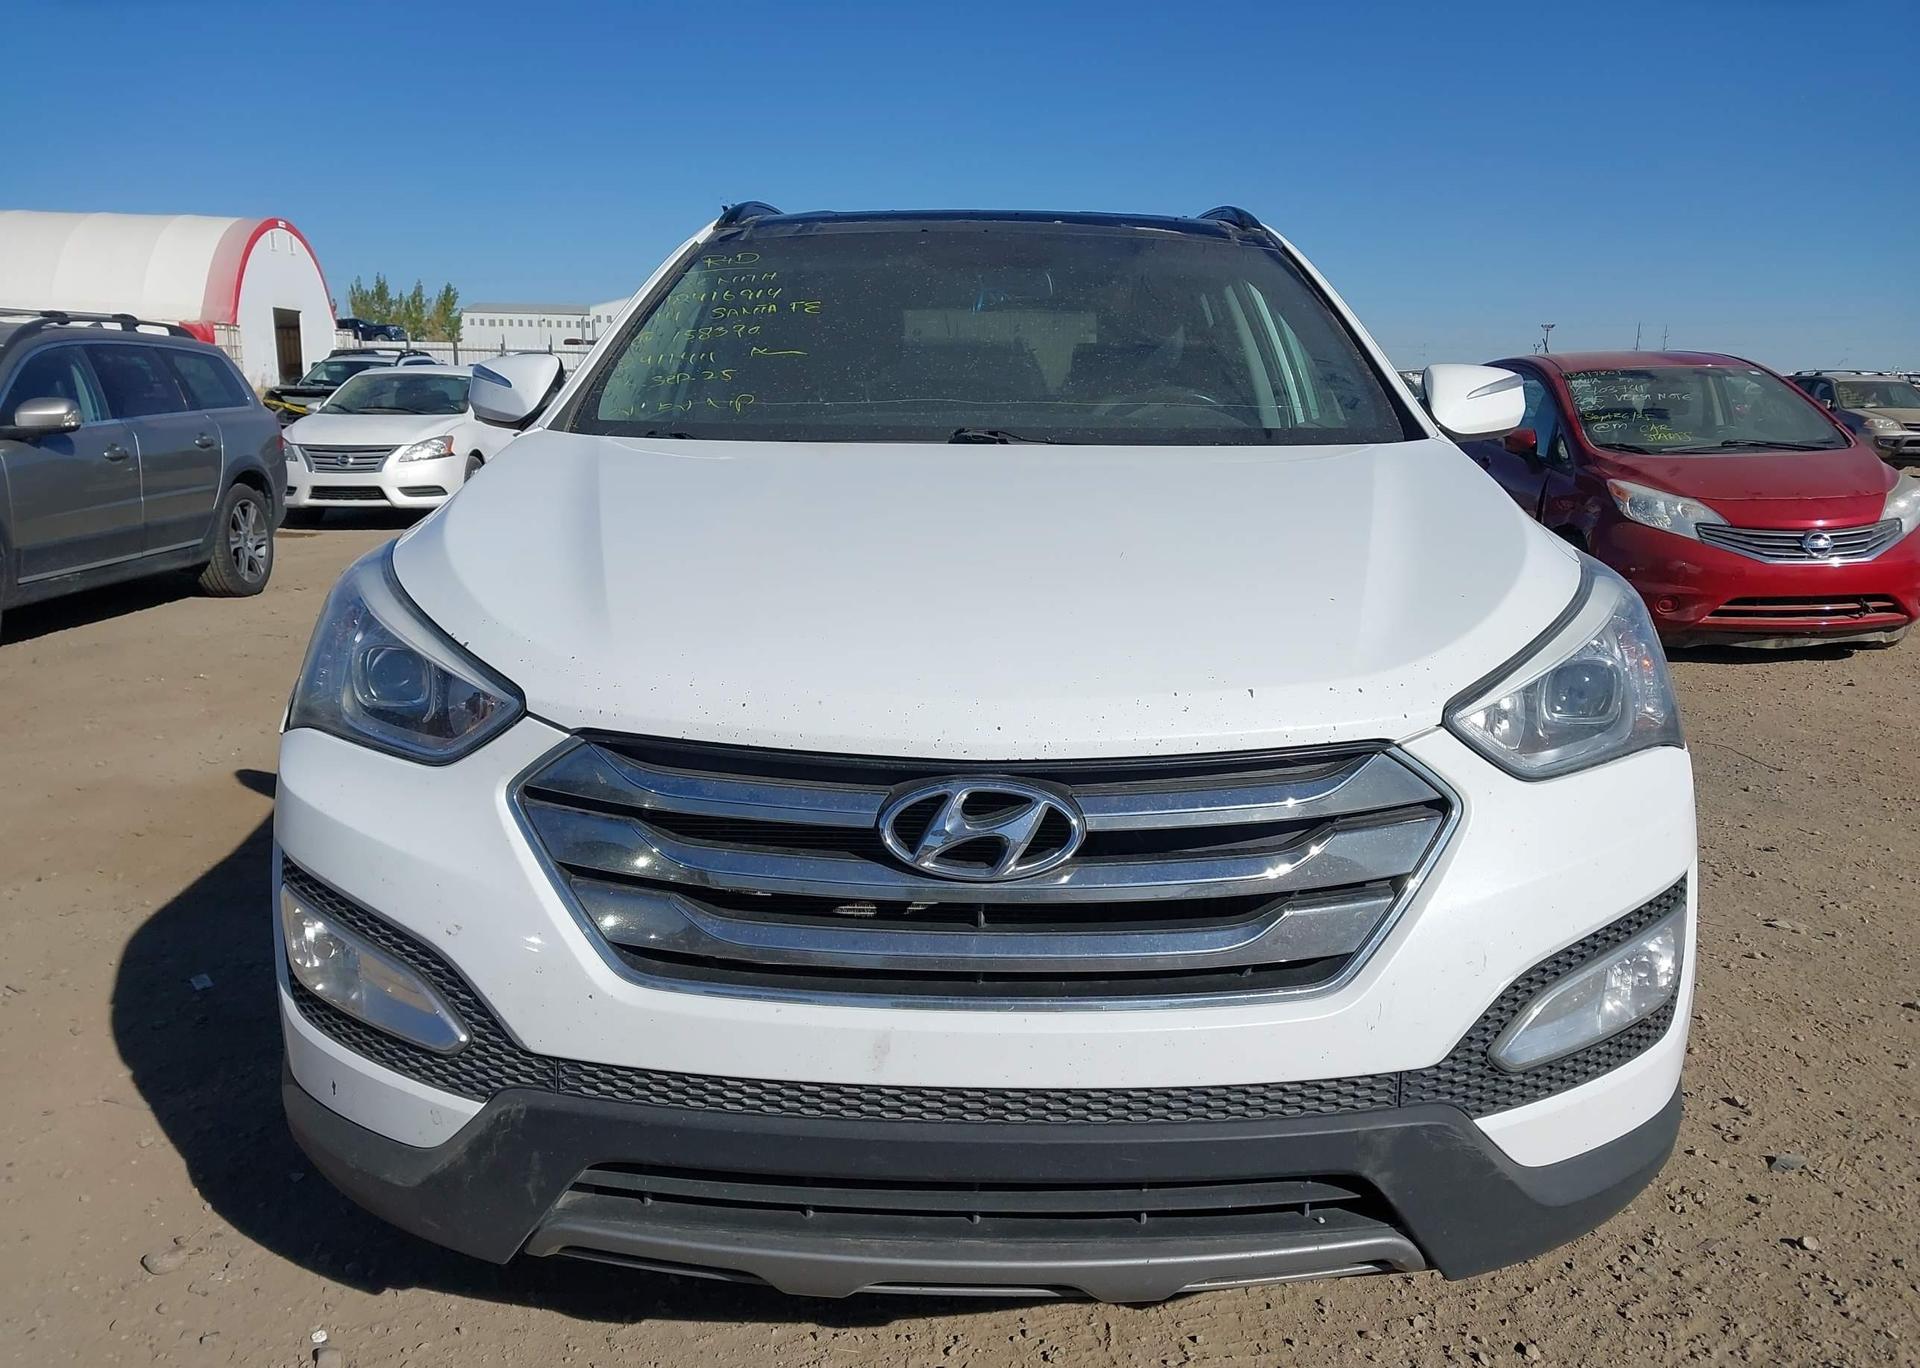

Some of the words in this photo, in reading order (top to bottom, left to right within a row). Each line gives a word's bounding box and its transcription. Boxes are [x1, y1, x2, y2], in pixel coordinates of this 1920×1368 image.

[710, 303, 777, 320] SANTA
[789, 301, 822, 315] FE
[1657, 394, 1694, 402] NOTE
